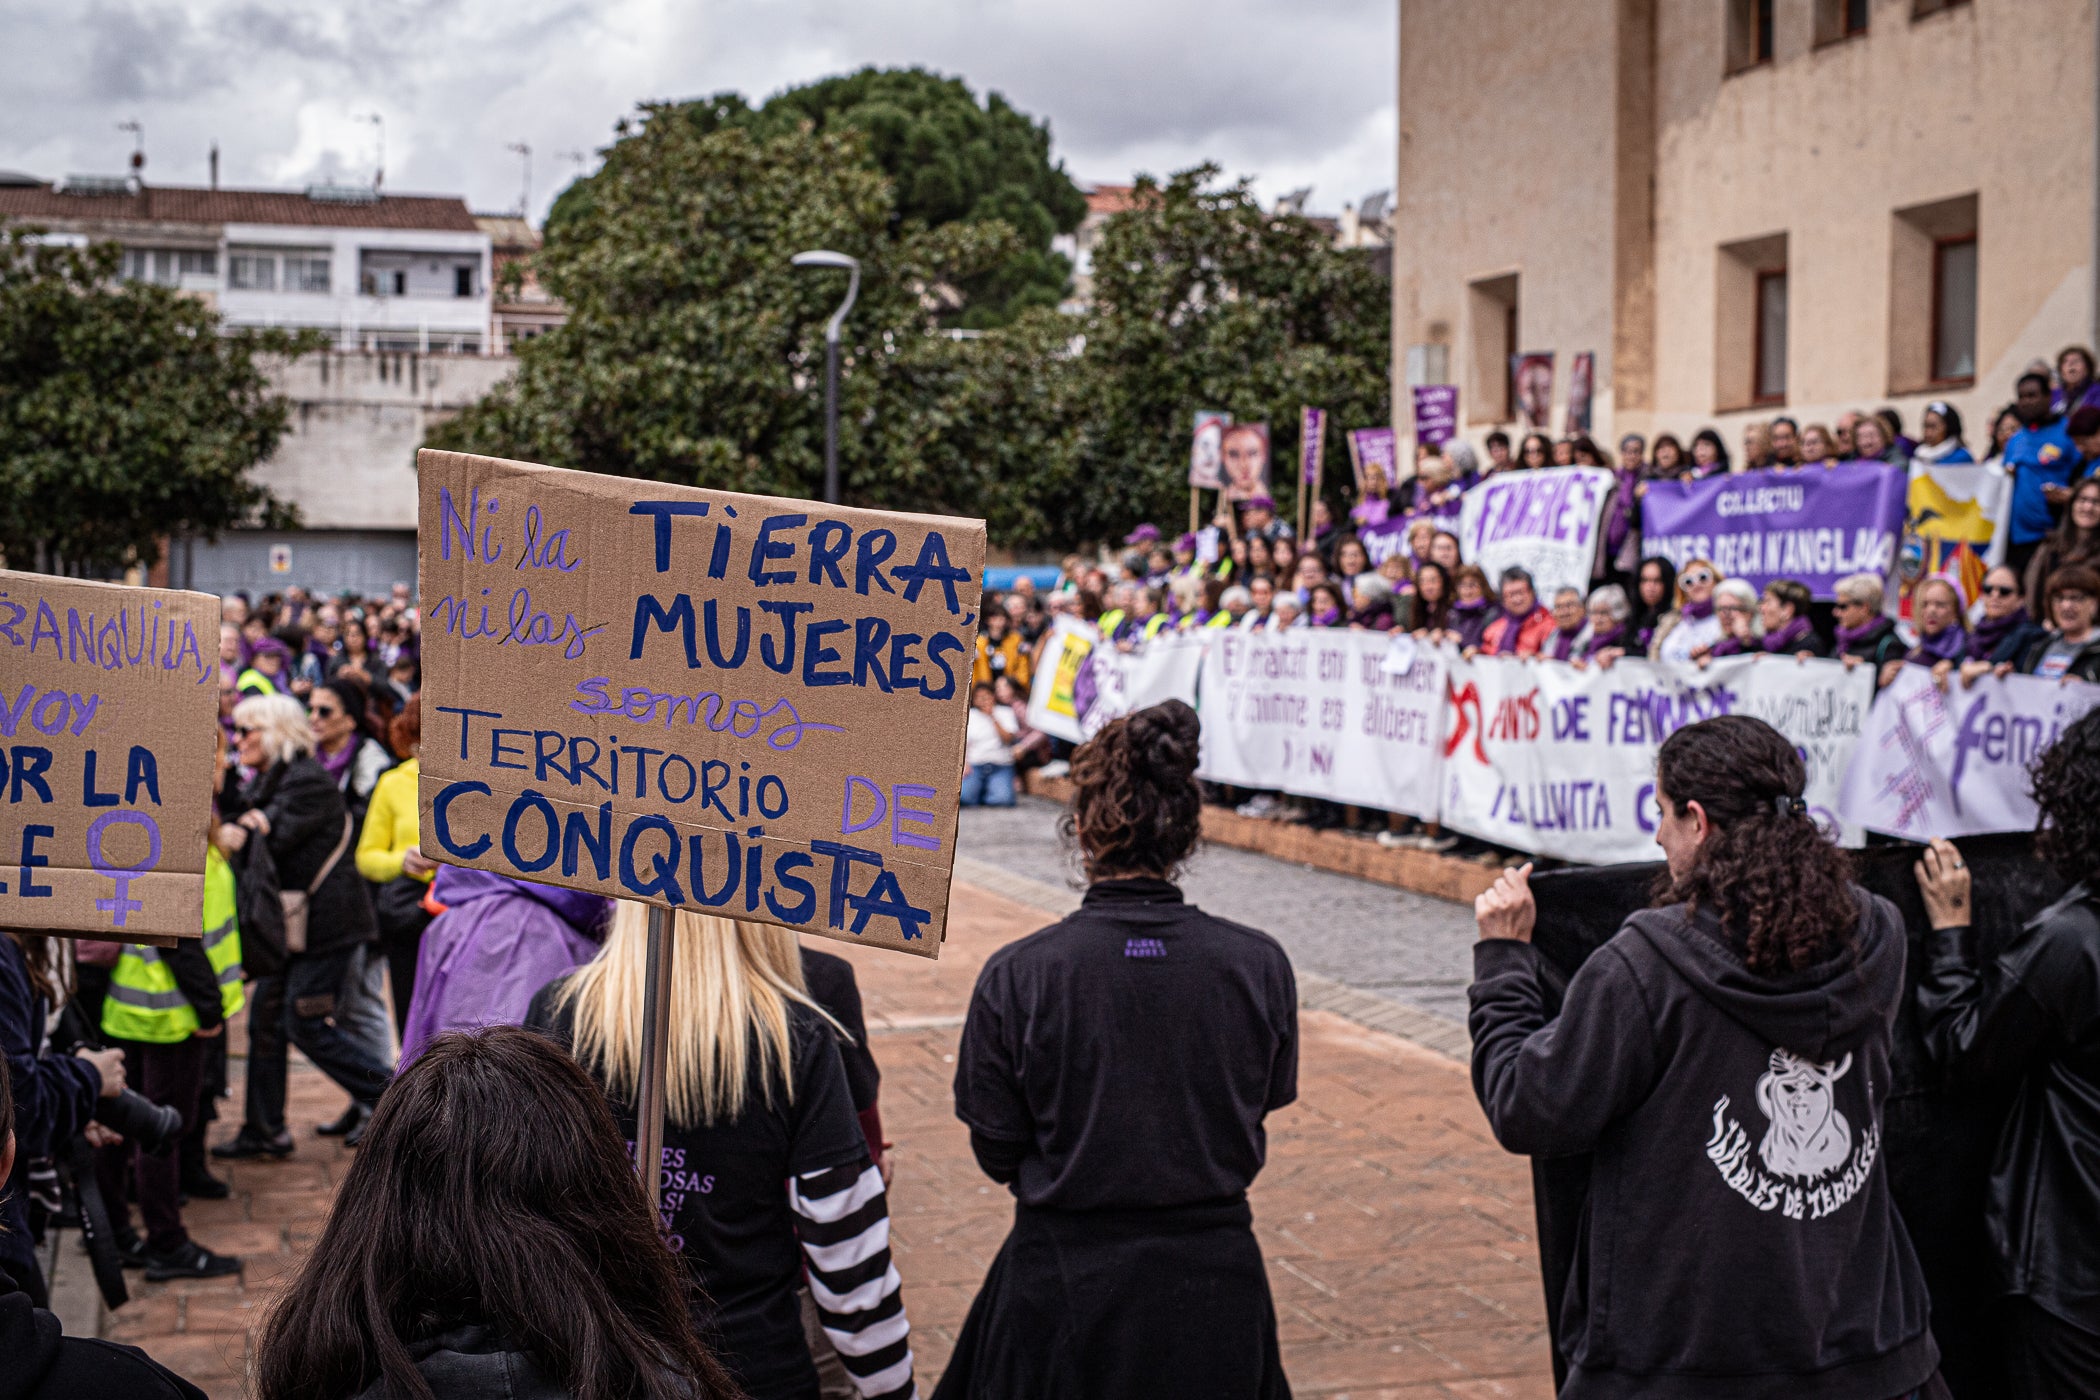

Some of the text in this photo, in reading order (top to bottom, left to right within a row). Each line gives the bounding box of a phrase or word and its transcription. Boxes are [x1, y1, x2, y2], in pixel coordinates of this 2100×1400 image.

[440, 486, 503, 564] Ni
[515, 504, 582, 572] la
[497, 588, 609, 660] las
[629, 593, 965, 701] MUJERES
[569, 676, 846, 751] somos
[83, 745, 161, 807] LA
[840, 775, 941, 850] DE
[1782, 1186, 1805, 1220] DE
